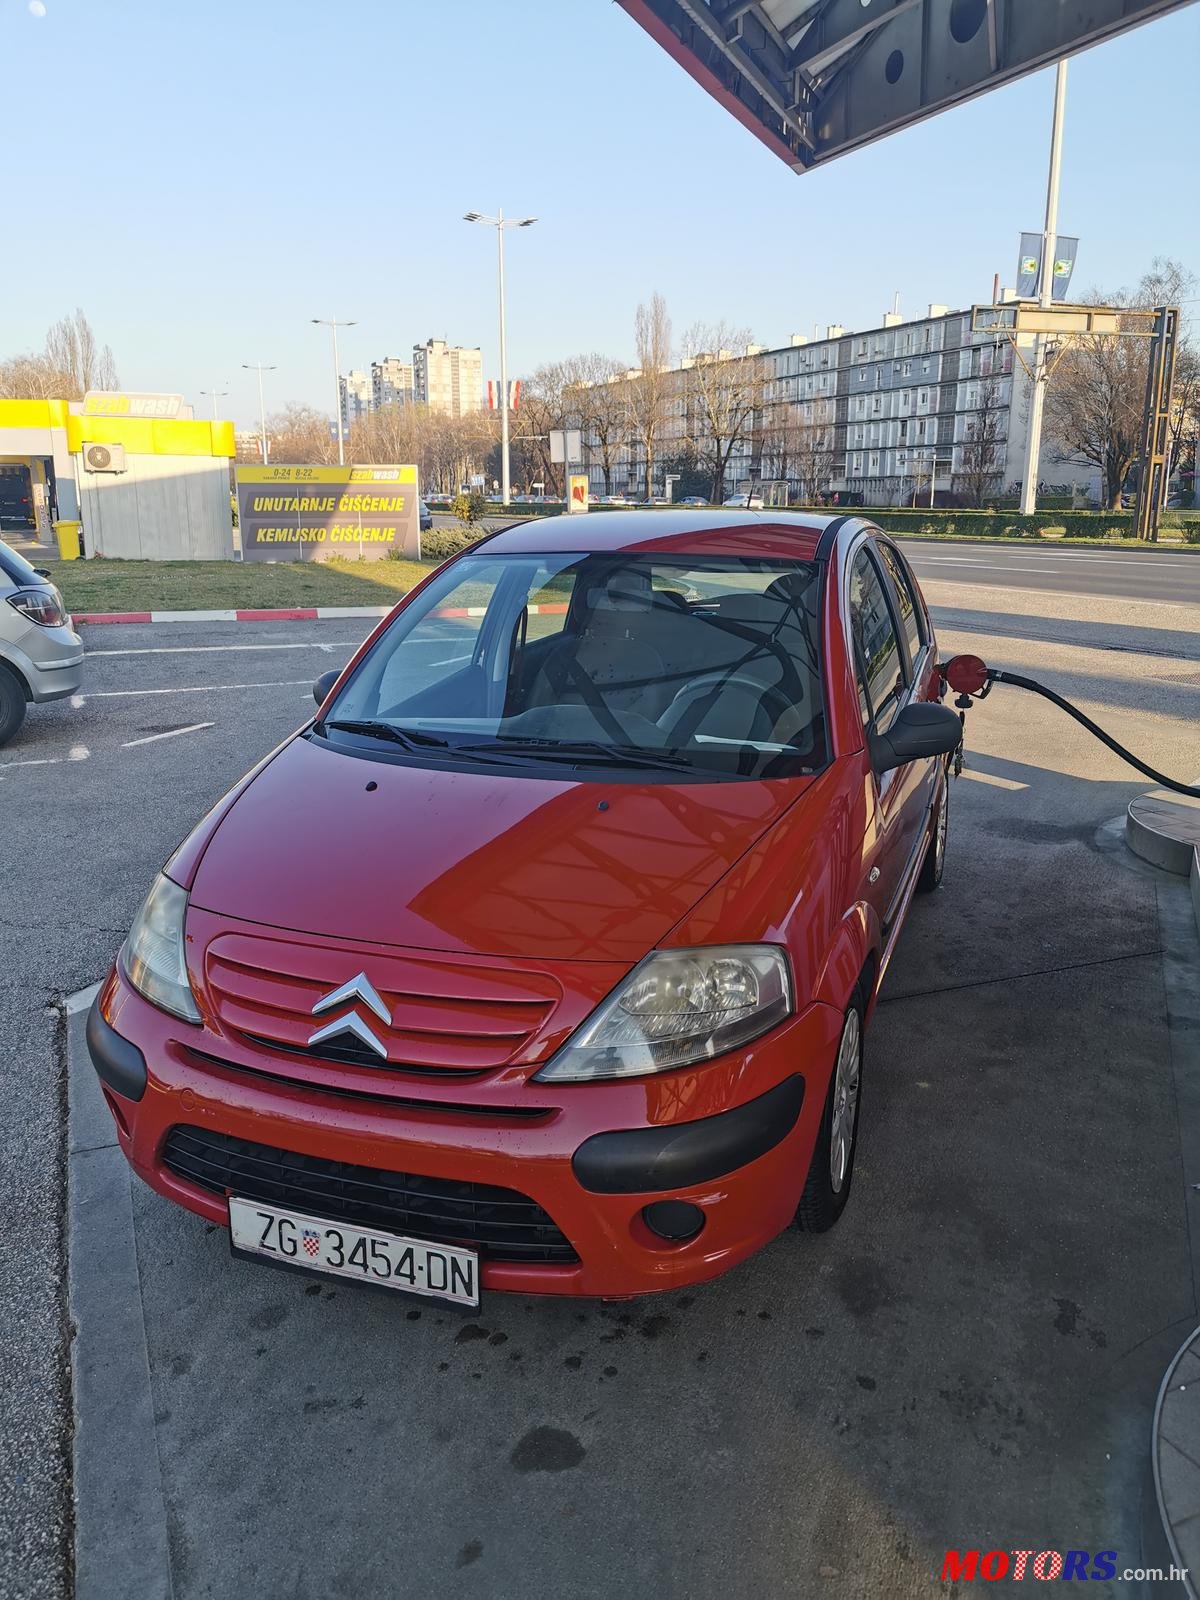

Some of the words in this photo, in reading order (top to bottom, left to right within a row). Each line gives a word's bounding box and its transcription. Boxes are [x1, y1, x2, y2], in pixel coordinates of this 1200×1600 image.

[273, 468, 291, 477] 0-24
[295, 468, 313, 477] 8-22
[253, 497, 336, 512] UNUTARNJE
[338, 494, 405, 512] ČIŠĆENJE
[256, 528, 327, 542] KEMIJSKO
[256, 1211, 298, 1257] ZG
